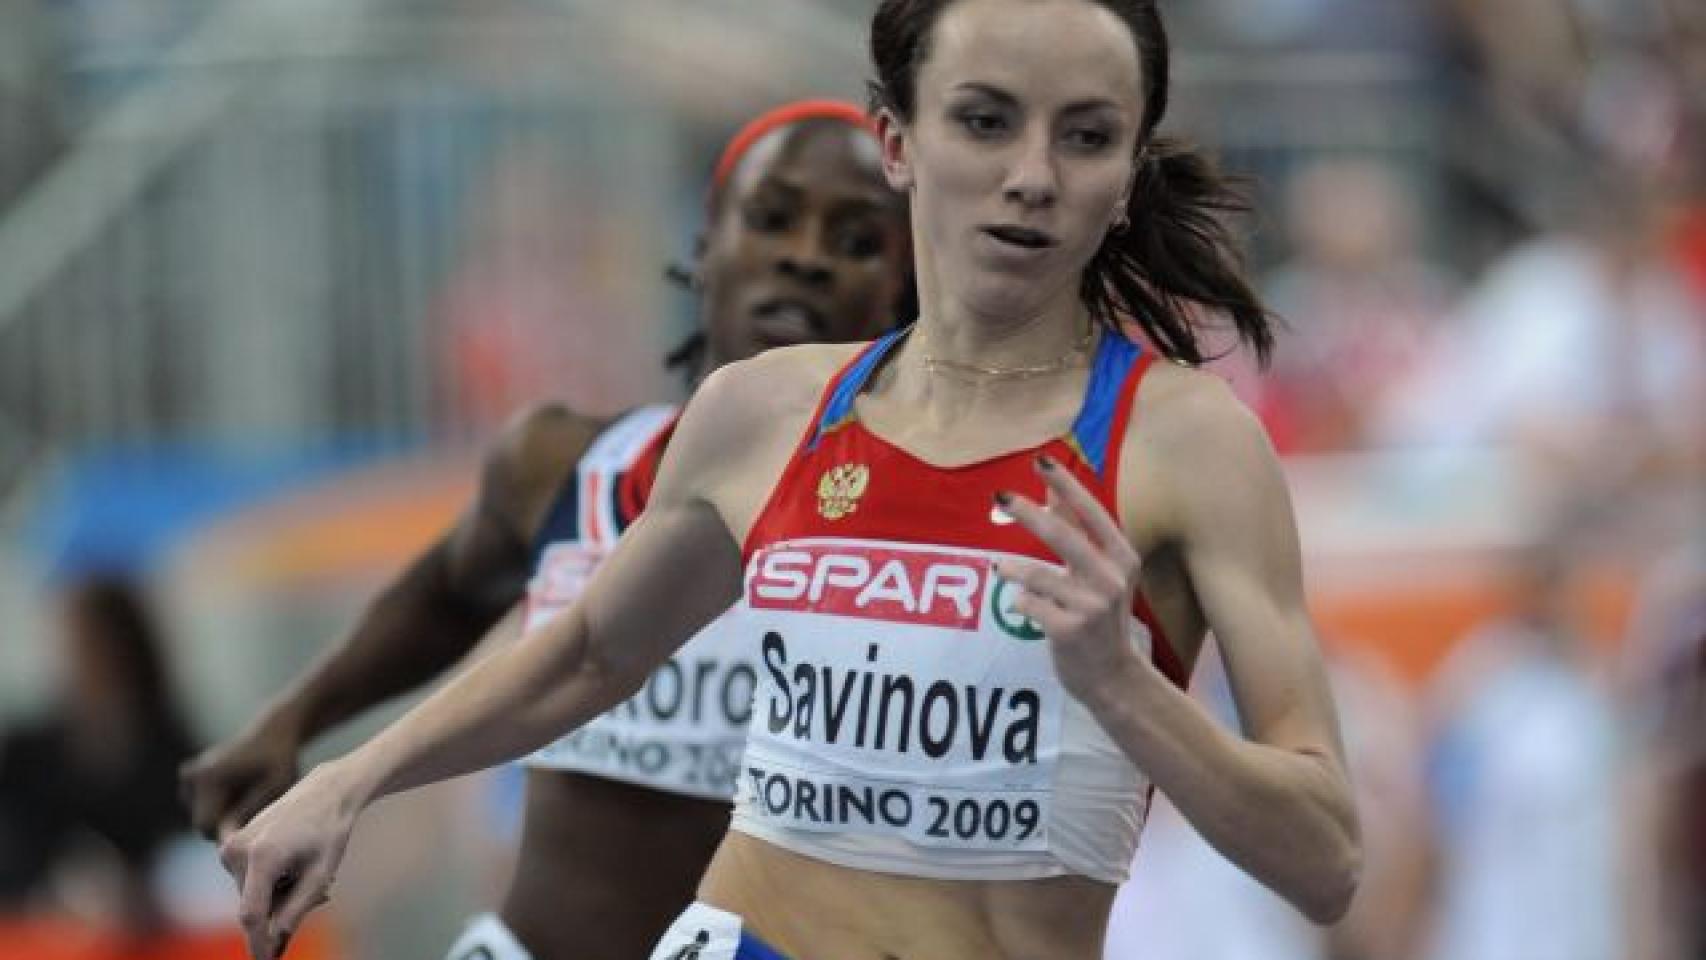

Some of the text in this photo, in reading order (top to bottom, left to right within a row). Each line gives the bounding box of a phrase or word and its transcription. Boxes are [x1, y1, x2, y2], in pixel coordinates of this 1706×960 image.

[755, 550, 979, 620] SPAR
[614, 657, 757, 727] oro
[762, 631, 1040, 763] Savinova
[748, 767, 1040, 841] TORINO 2009
